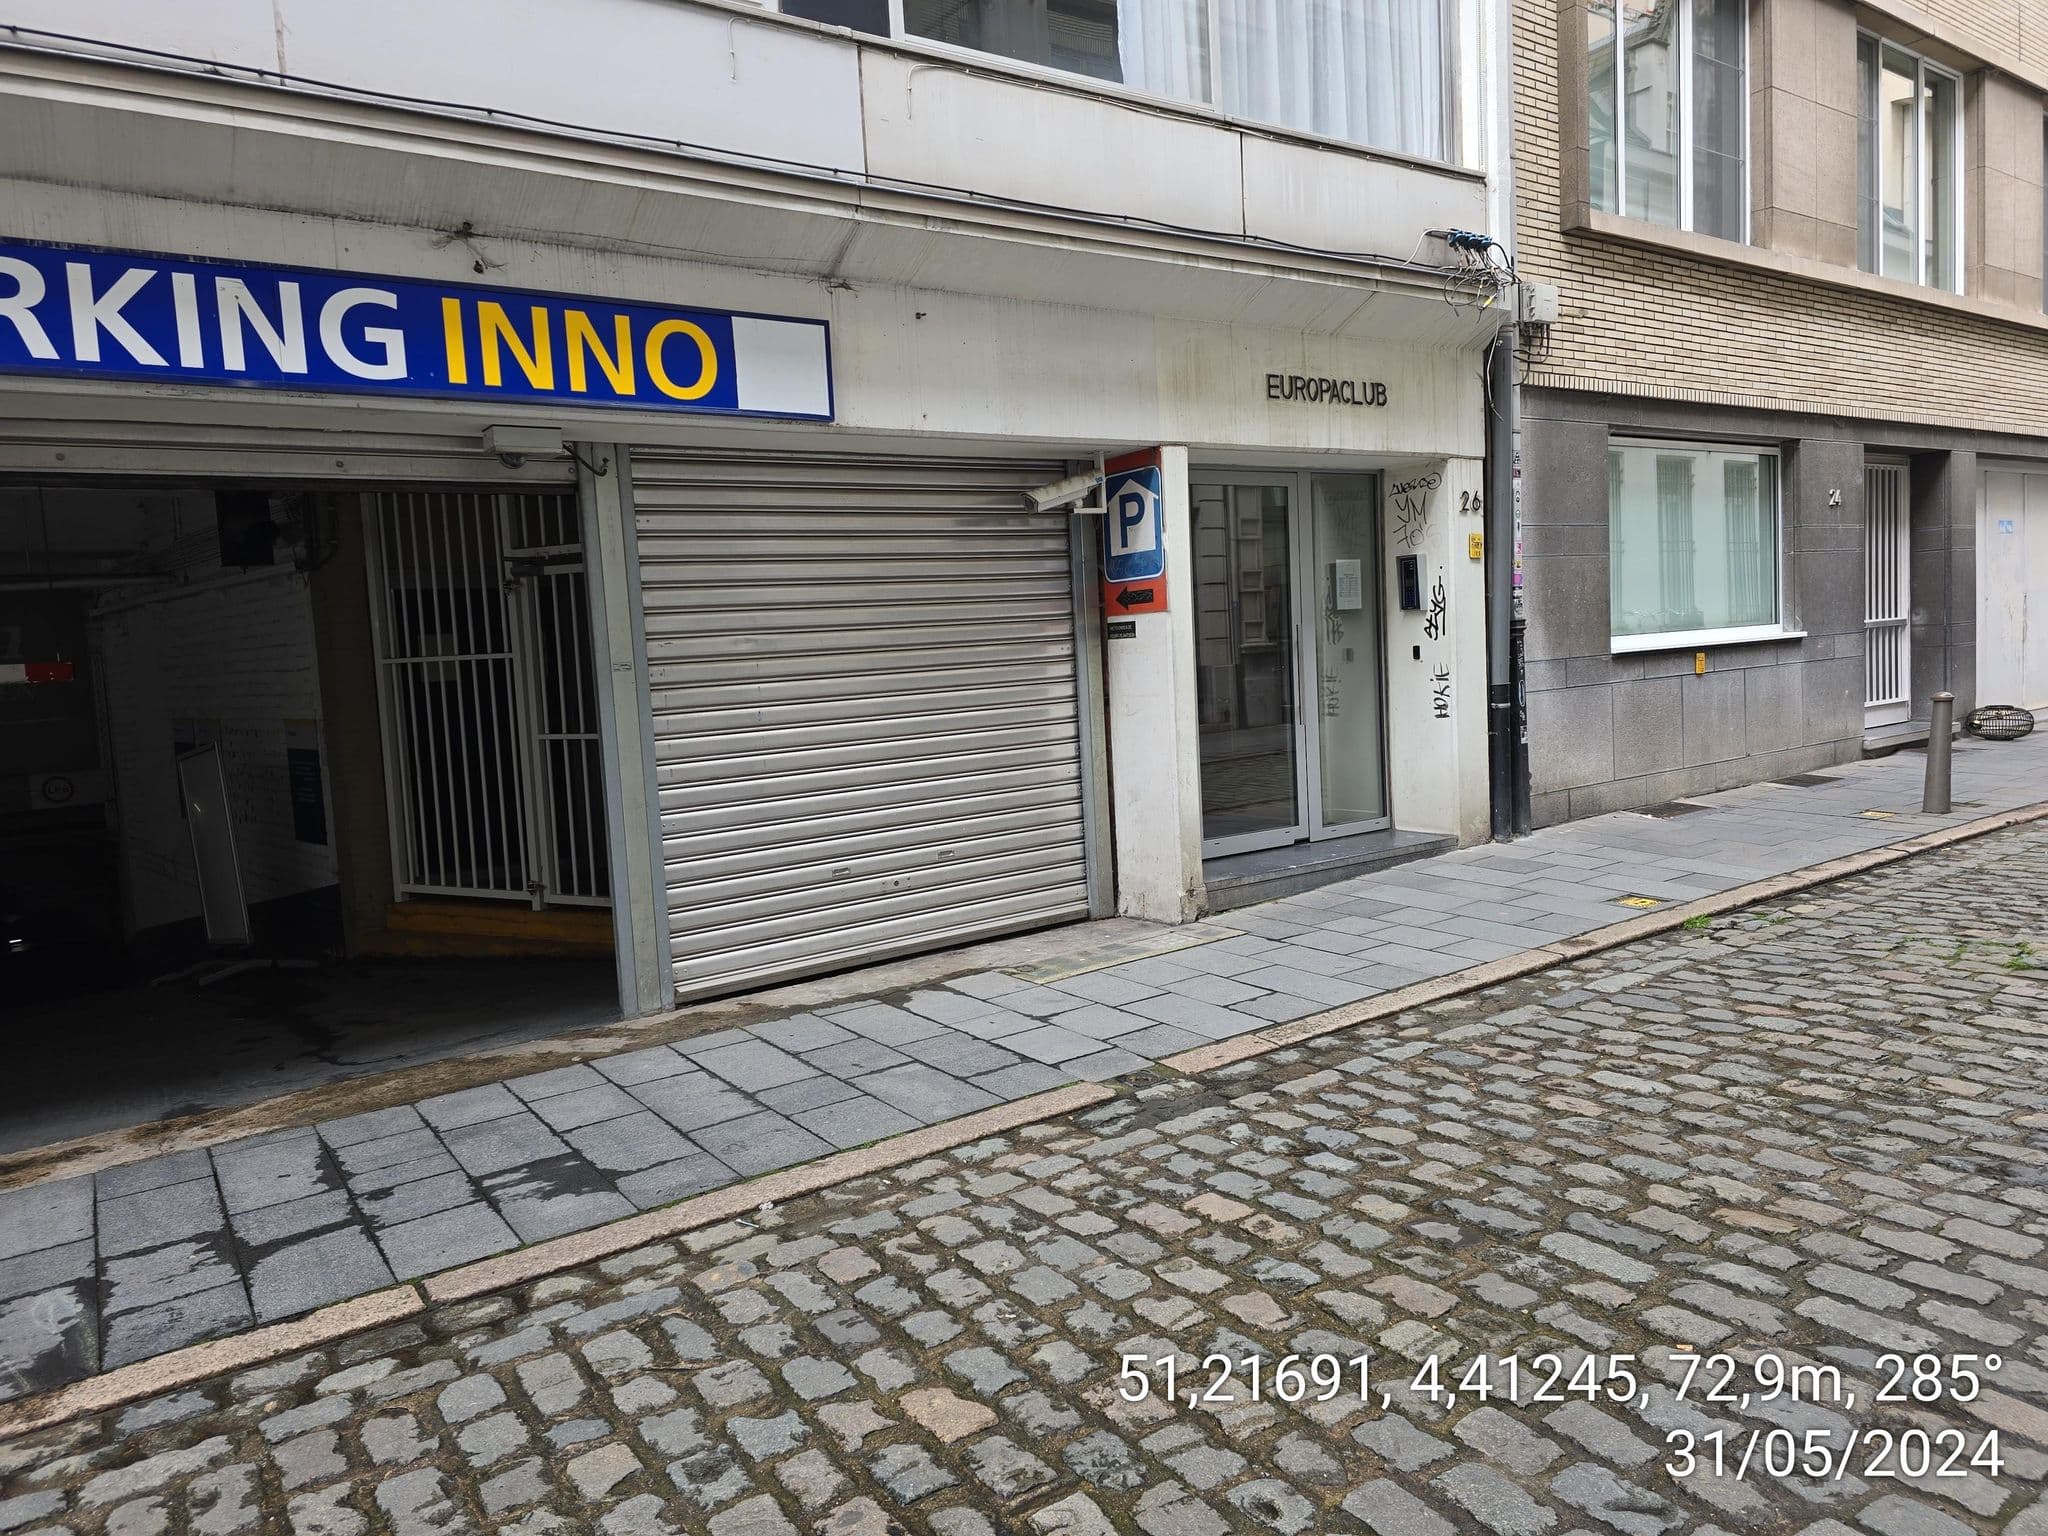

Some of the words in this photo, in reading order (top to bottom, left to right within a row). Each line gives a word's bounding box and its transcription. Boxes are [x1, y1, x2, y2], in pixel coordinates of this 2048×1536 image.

[441, 296, 719, 401] INNO
[1266, 373, 1388, 407] EUROPACLUB
[1459, 490, 1480, 512] 26
[1829, 488, 1841, 506] 24
[1119, 492, 1145, 548] P
